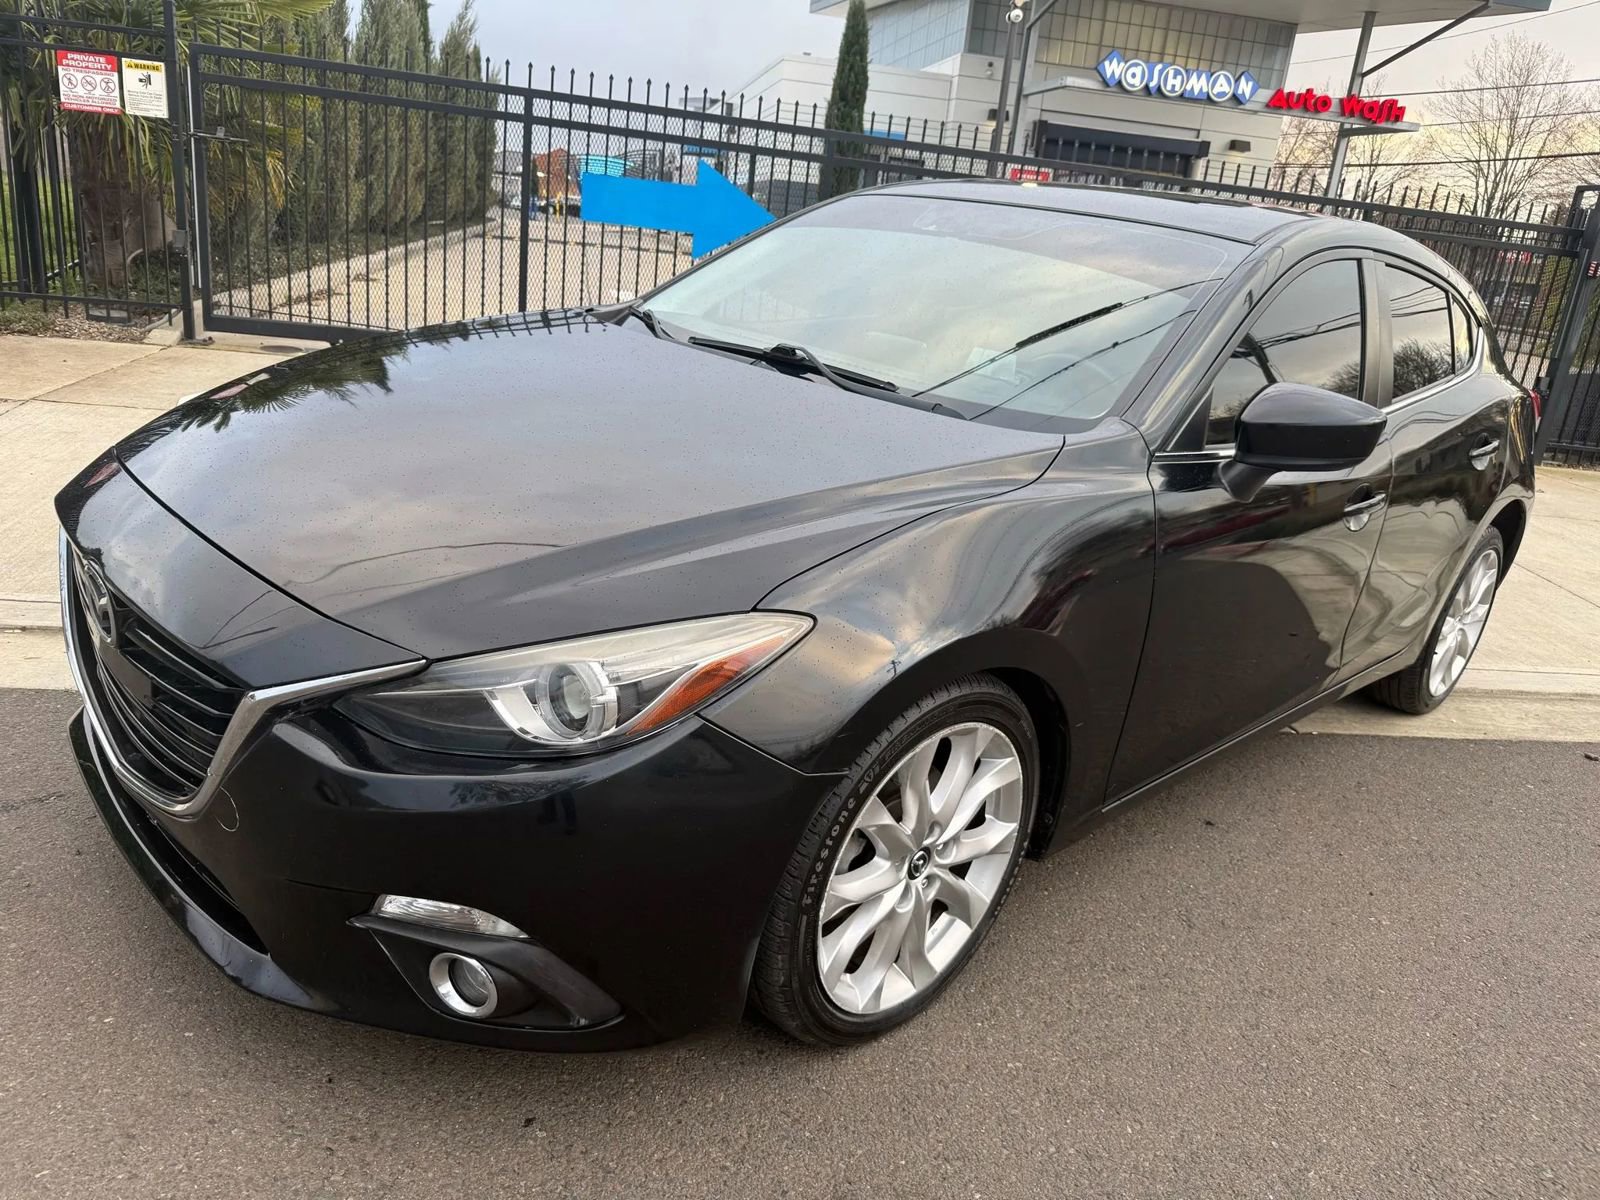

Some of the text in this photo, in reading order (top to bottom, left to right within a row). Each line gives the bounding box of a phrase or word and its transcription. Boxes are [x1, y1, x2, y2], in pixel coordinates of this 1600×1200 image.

[67, 53, 106, 63] PRIVATE
[62, 59, 112, 70] PROPERTY
[133, 63, 160, 71] WARNING
[72, 68, 114, 77] TRESPASSING
[1265, 87, 1333, 113] Auto
[63, 103, 102, 111] CUSTOMERS
[802, 797, 856, 907] Firestone
